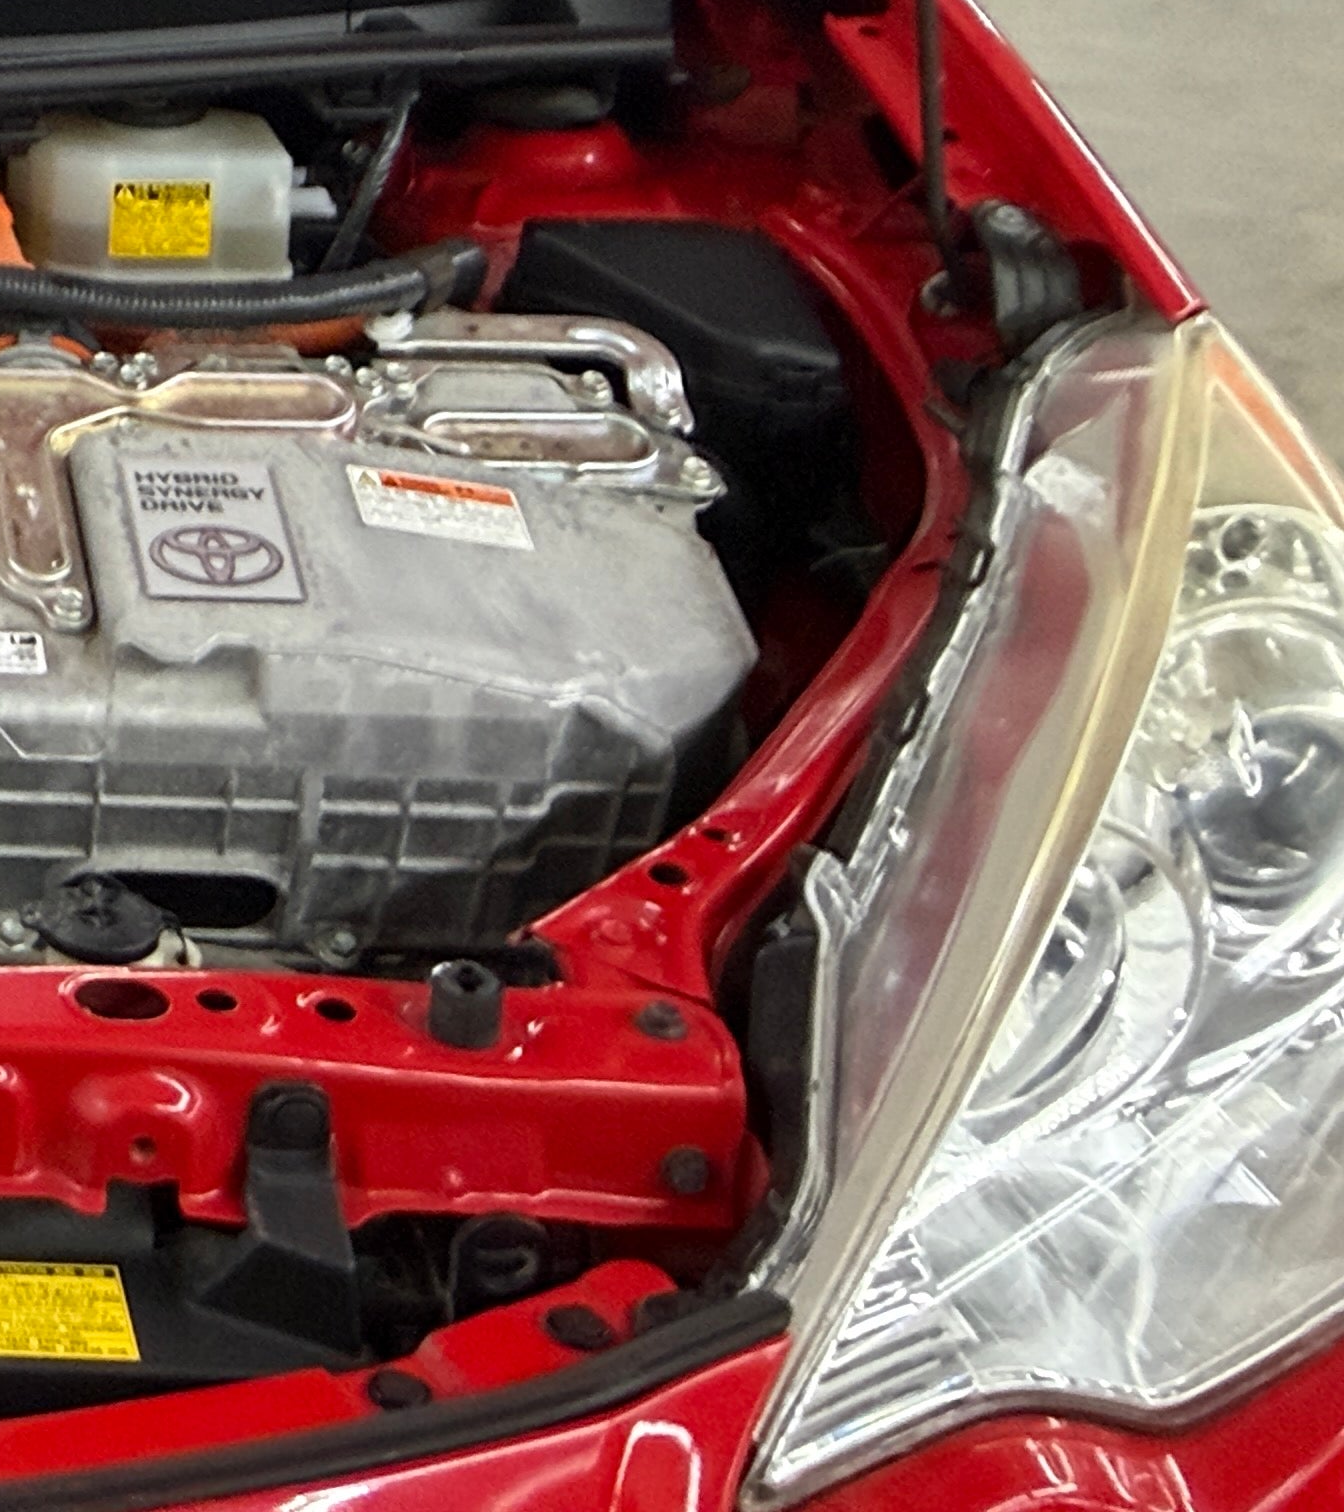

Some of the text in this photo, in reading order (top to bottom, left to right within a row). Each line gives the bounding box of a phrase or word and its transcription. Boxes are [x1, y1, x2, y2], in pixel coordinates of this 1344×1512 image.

[134, 471, 239, 485] HYBRID
[137, 485, 265, 500] SYNERGY
[140, 500, 224, 513] DRIVE
